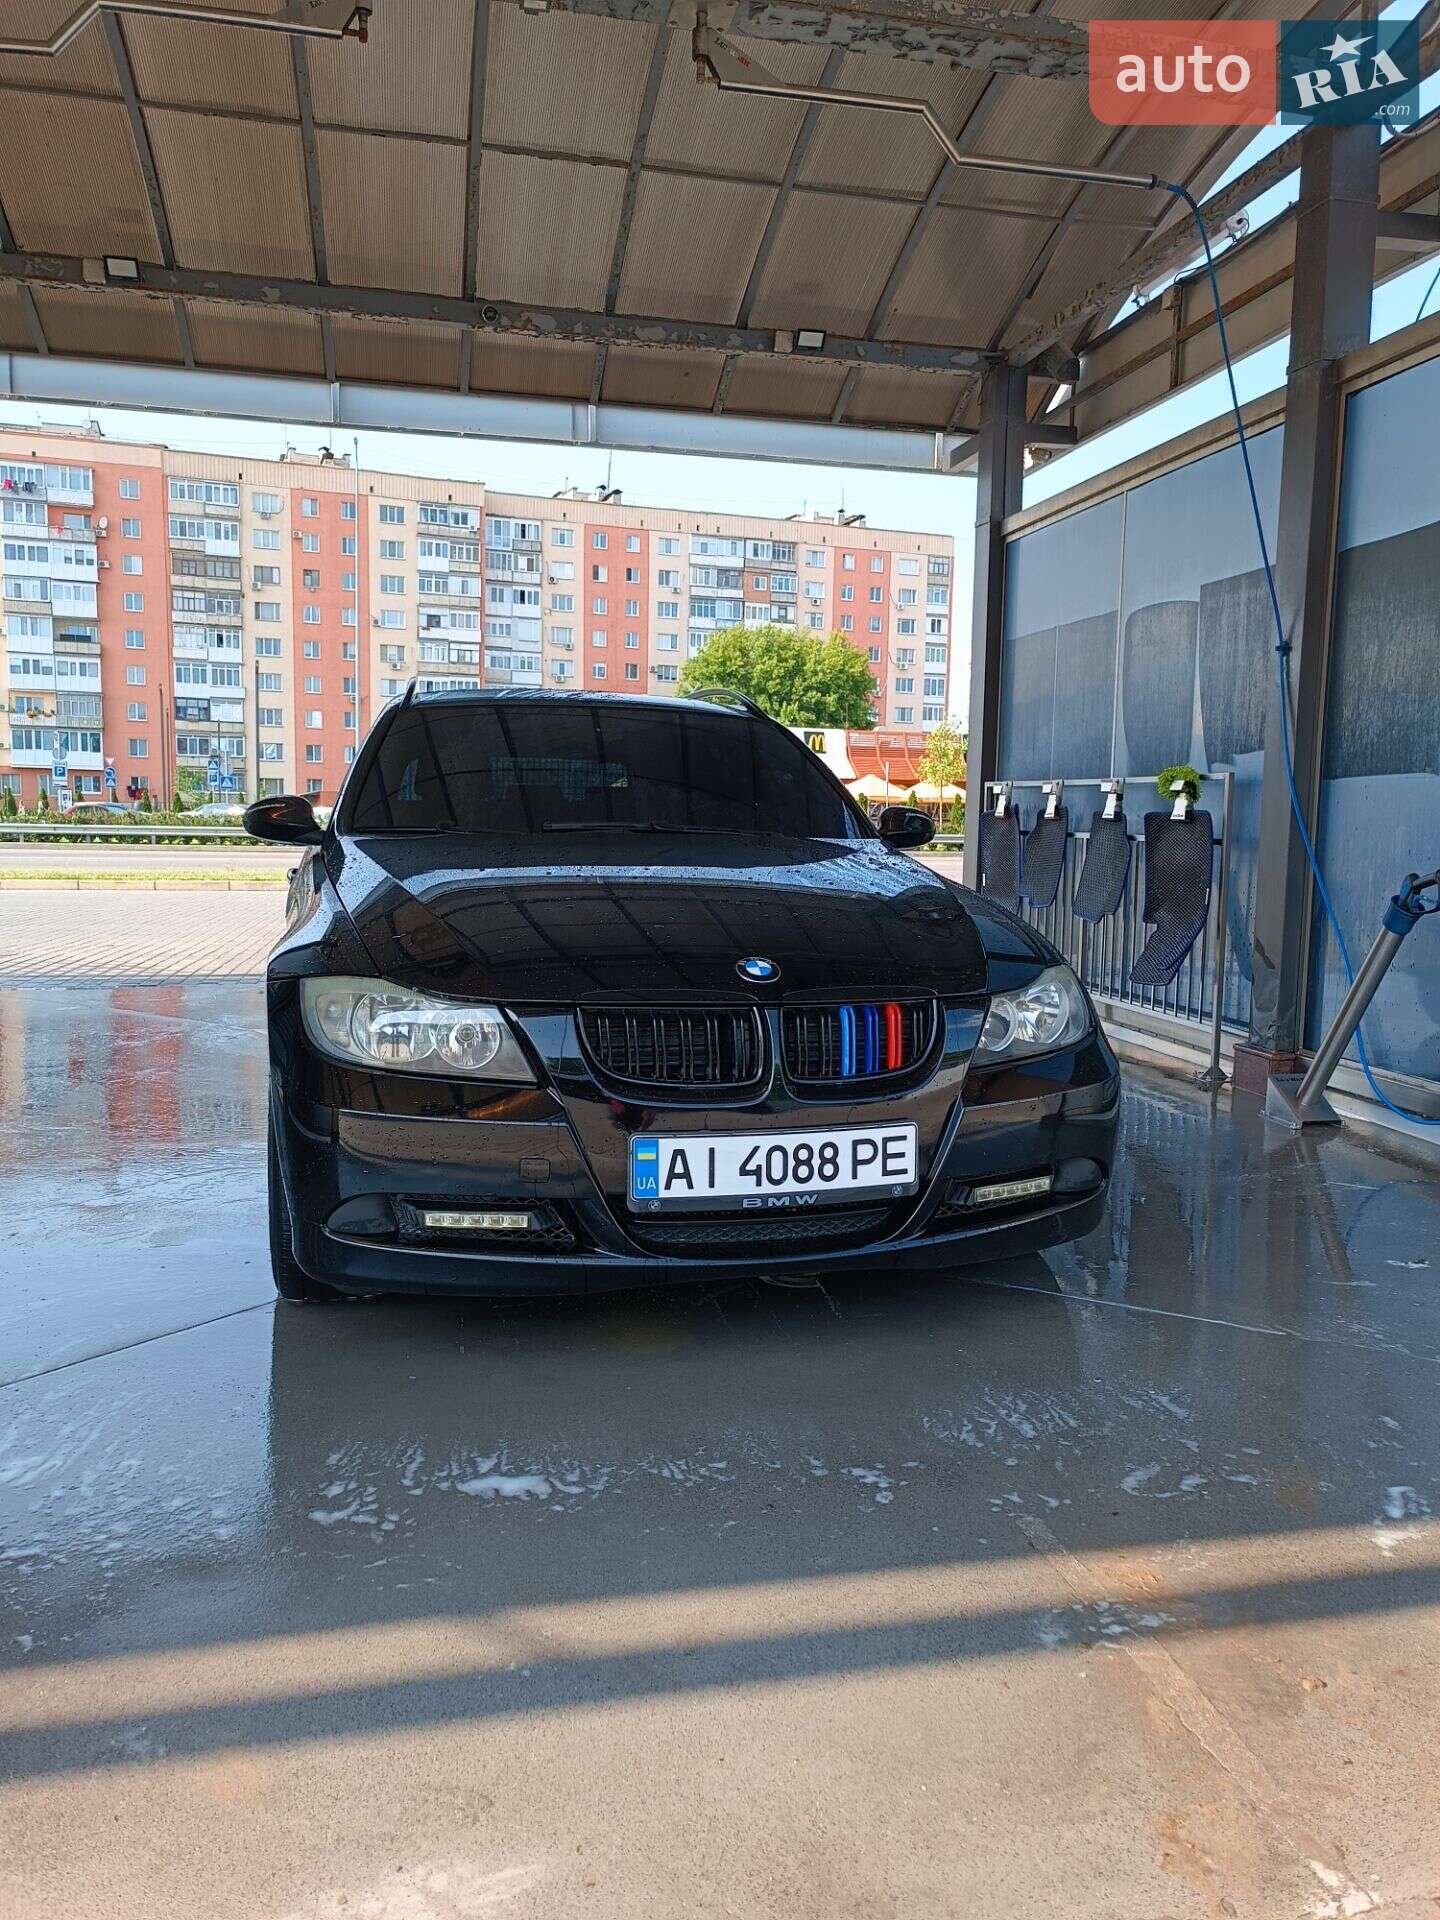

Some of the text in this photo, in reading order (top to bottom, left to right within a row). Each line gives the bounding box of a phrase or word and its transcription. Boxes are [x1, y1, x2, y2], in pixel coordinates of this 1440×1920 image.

[739, 1141, 840, 1187] 4088
[851, 1135, 908, 1180] PE
[637, 1176, 657, 1190] UA
[742, 1193, 819, 1209] BMW
